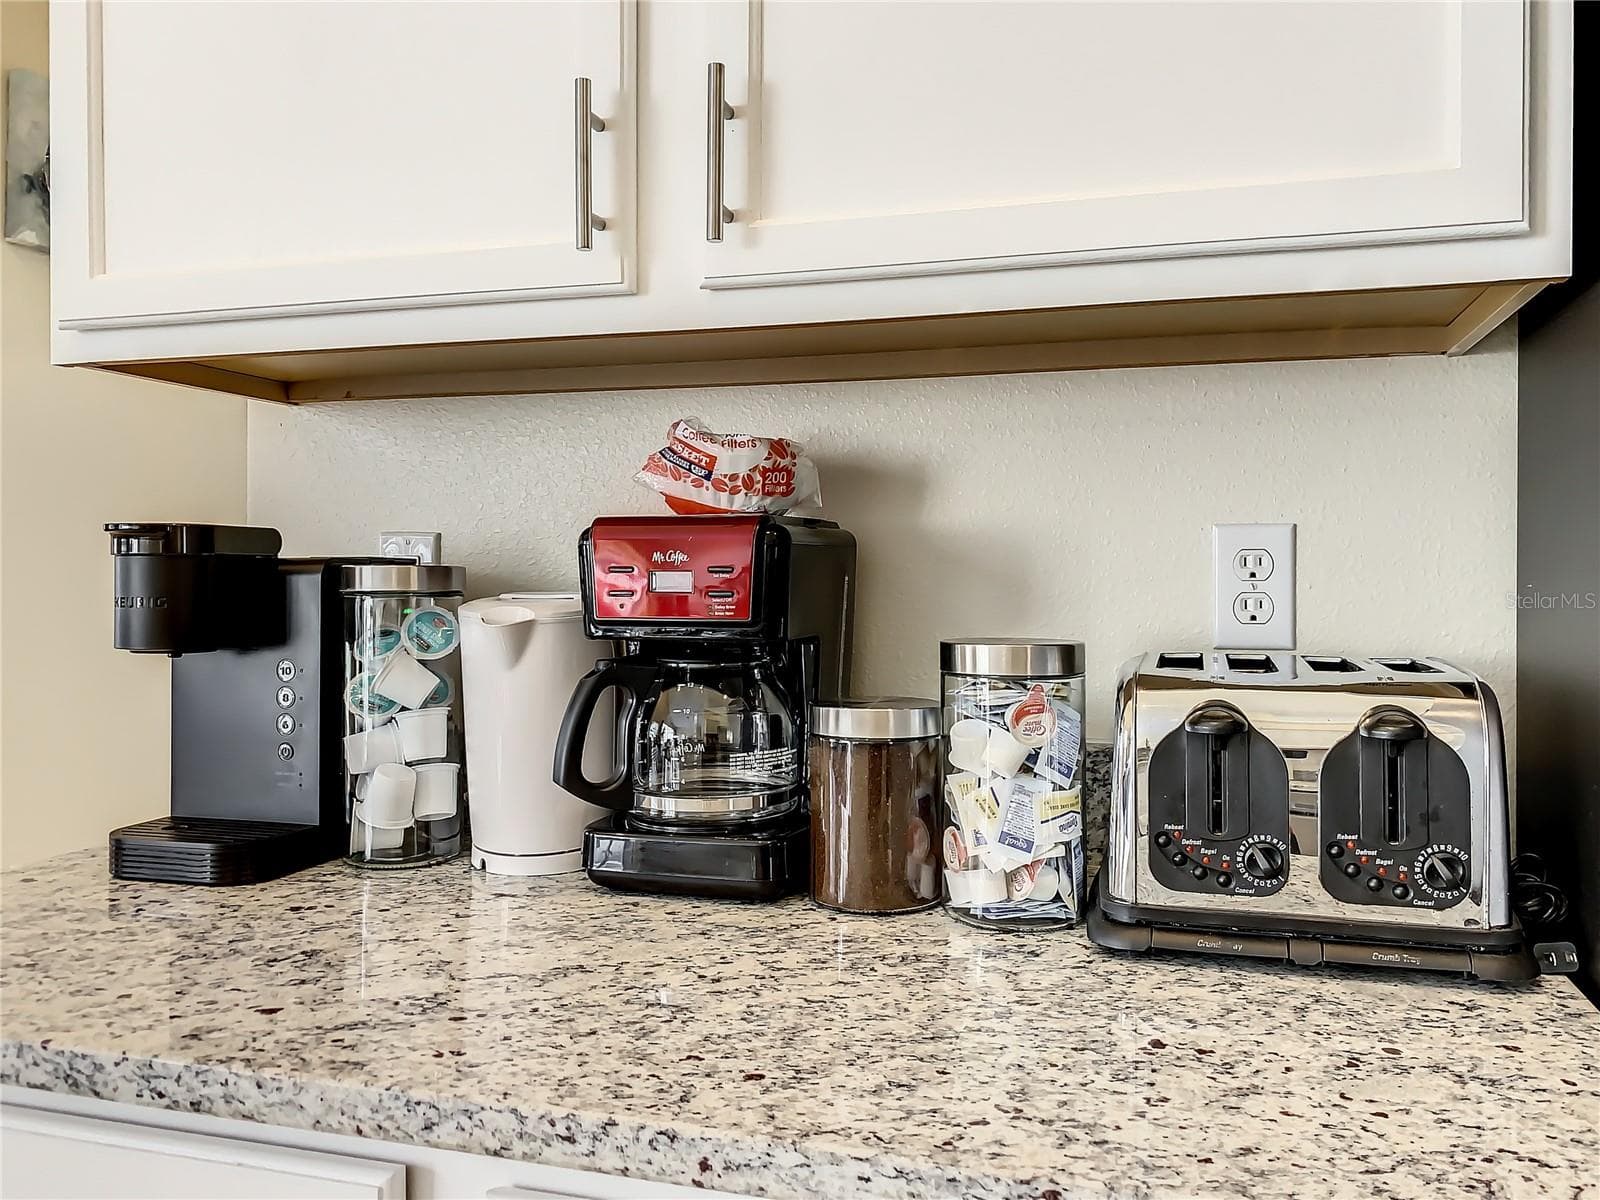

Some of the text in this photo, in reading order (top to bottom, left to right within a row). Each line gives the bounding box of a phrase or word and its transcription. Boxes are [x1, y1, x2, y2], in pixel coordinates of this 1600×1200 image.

[682, 427, 717, 445] Coffee
[721, 438, 757, 449] Filters
[765, 472, 787, 484] 200
[666, 550, 690, 566] Coffee
[114, 596, 168, 609] KEURIG
[280, 667, 292, 676] 10
[283, 693, 289, 702] 8
[282, 720, 289, 729] 6
[1023, 726, 1046, 736] Coffee
[1005, 836, 1029, 849] equal
[1181, 838, 1202, 846] Defrost
[1276, 841, 1287, 851] 10
[1200, 847, 1217, 855] Bagel
[1458, 851, 1469, 861] 10
[1376, 858, 1394, 866] Bagel
[1413, 899, 1435, 907] Cancel
[1372, 952, 1400, 962] Crumb
